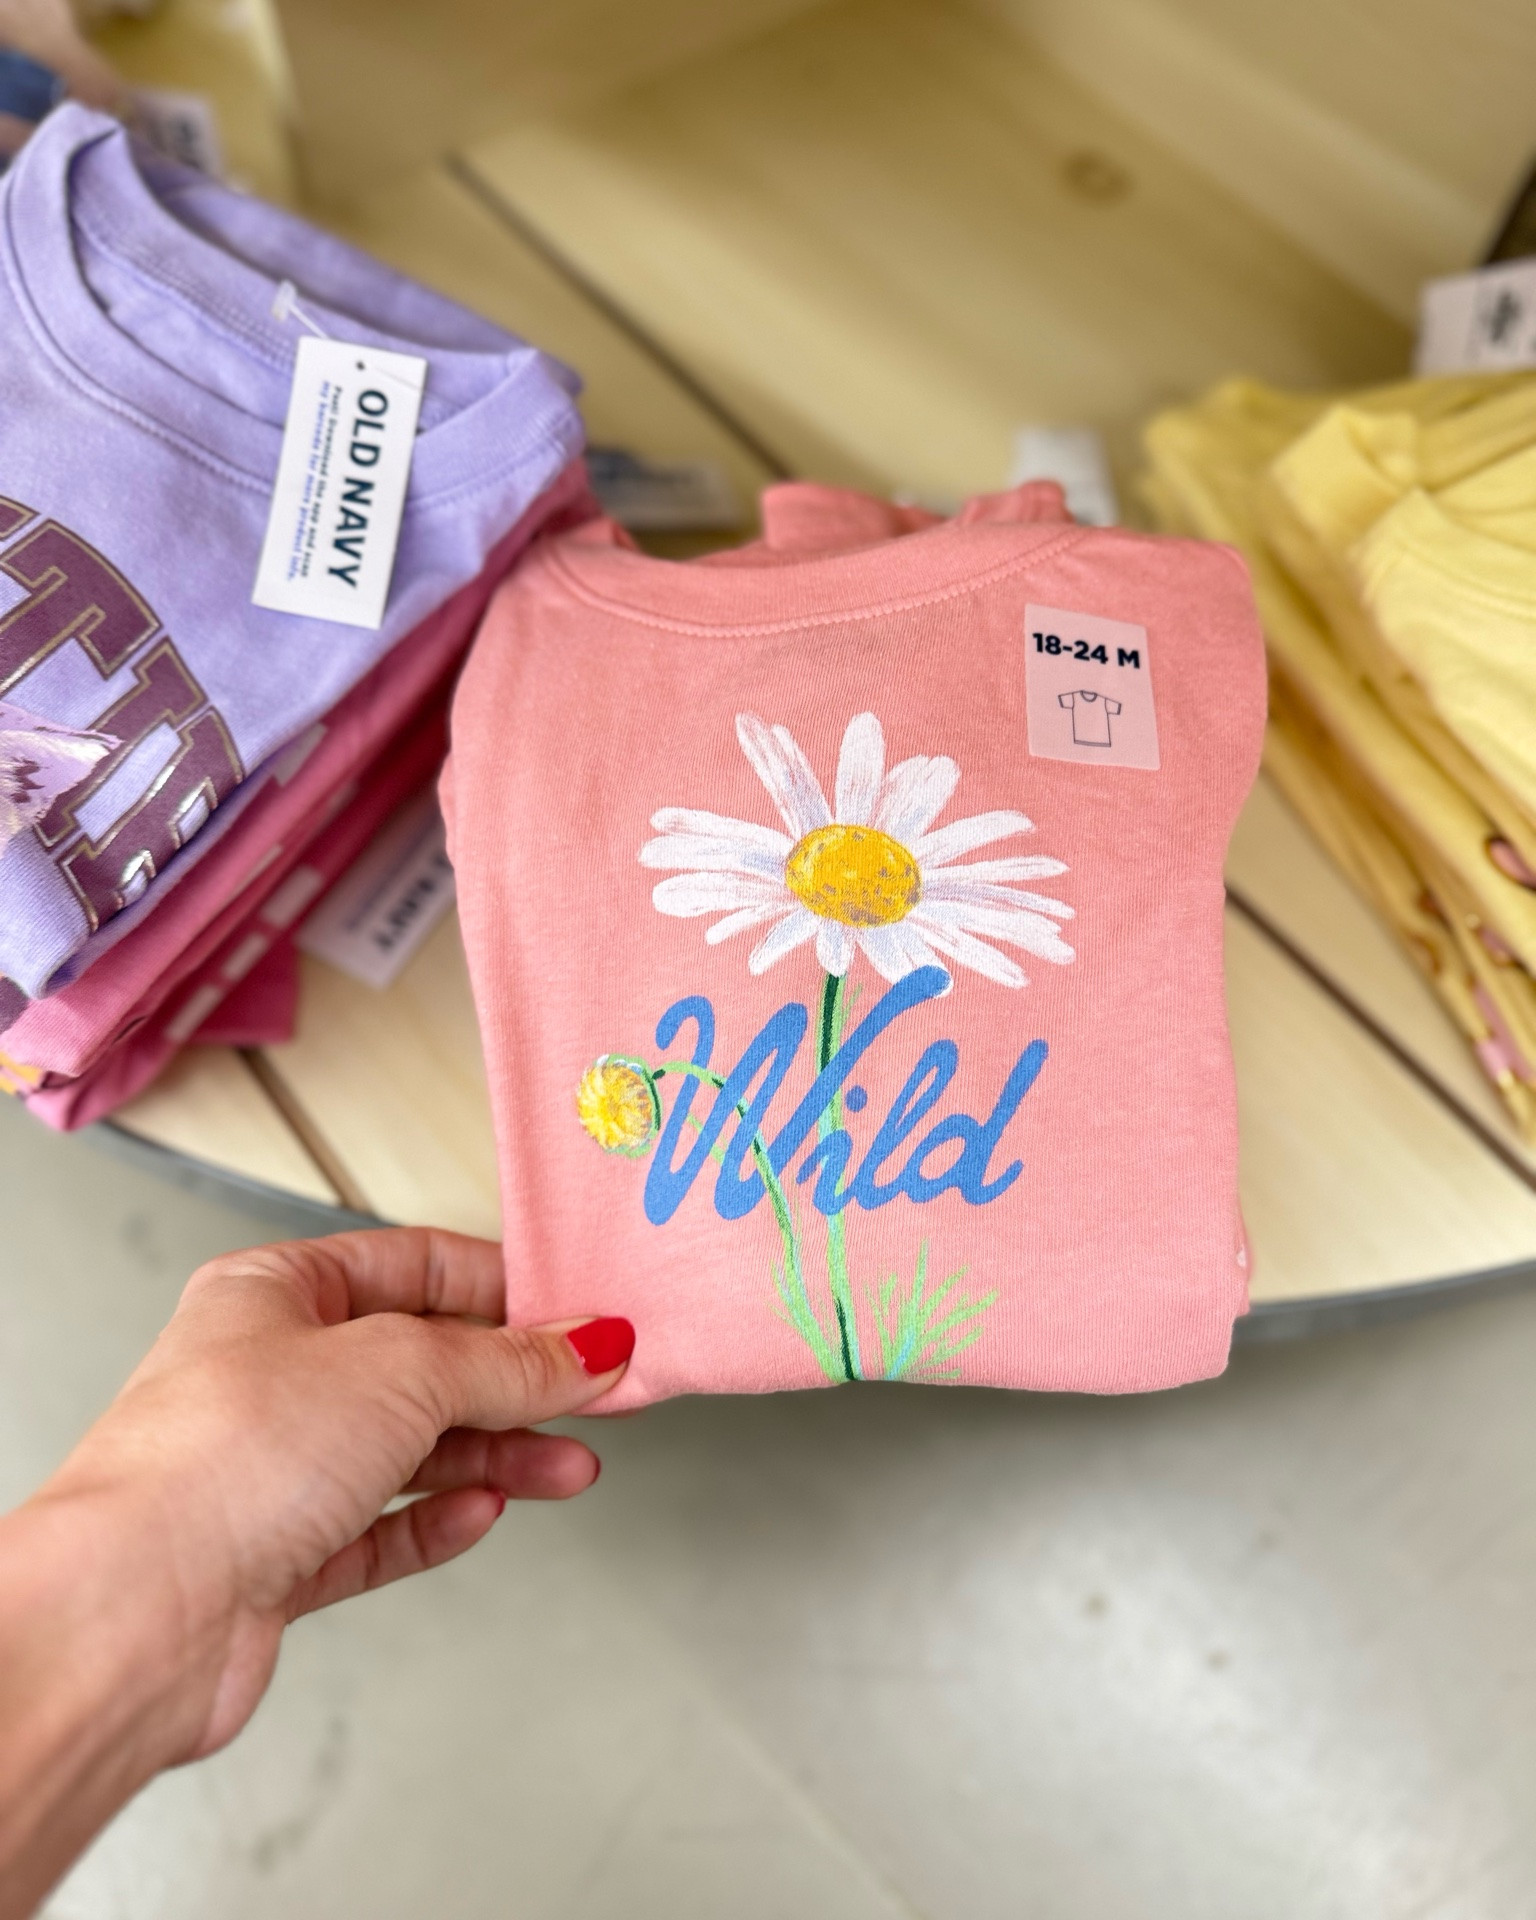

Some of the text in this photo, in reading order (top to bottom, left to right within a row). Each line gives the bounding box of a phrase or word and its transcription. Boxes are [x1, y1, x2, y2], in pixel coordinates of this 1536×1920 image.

[319, 418, 336, 476] Download
[314, 479, 325, 498] the
[328, 389, 389, 589] OLD NAVY
[291, 506, 308, 552] product
[308, 501, 320, 523] app
[306, 527, 317, 548] and
[1032, 632, 1140, 669] 18-24 M
[644, 965, 1048, 1226] Wild
